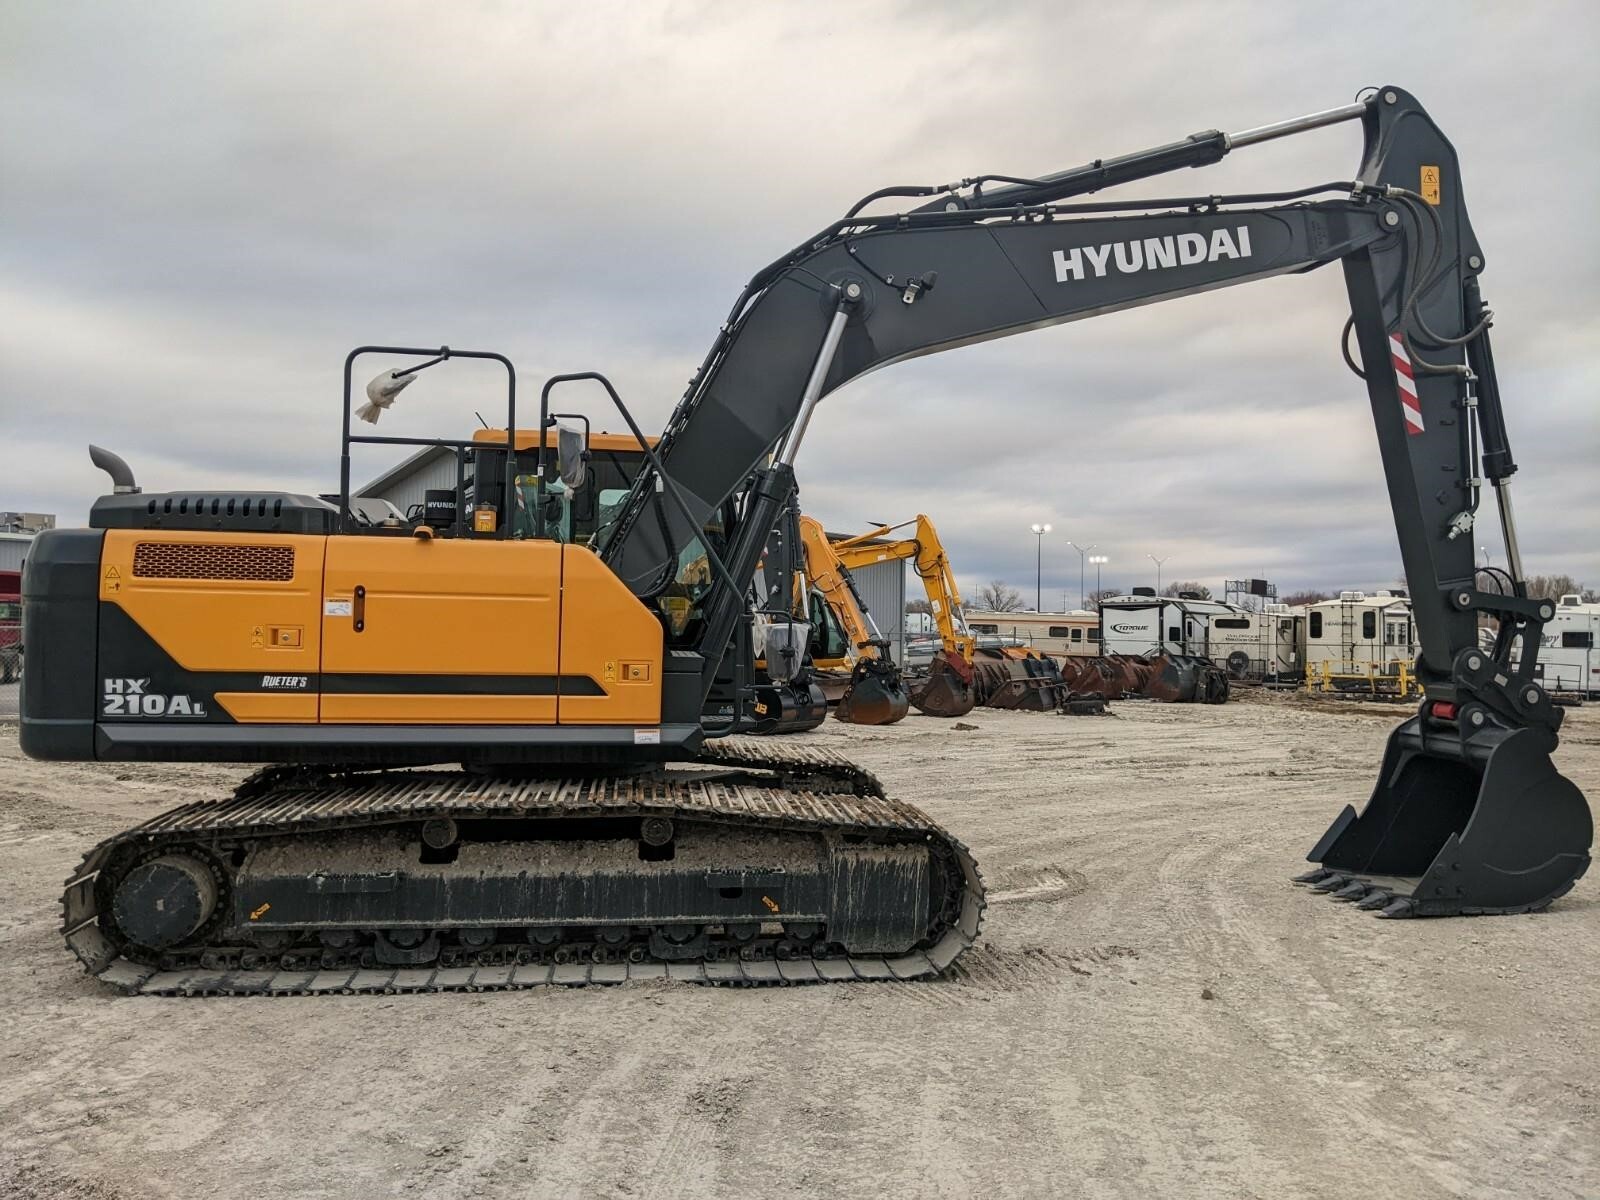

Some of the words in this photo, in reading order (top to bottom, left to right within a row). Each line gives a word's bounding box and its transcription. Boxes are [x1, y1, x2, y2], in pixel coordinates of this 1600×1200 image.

[1052, 225, 1252, 283] HYUNDAI
[104, 679, 146, 694] HX
[262, 675, 308, 688] RUETER'S
